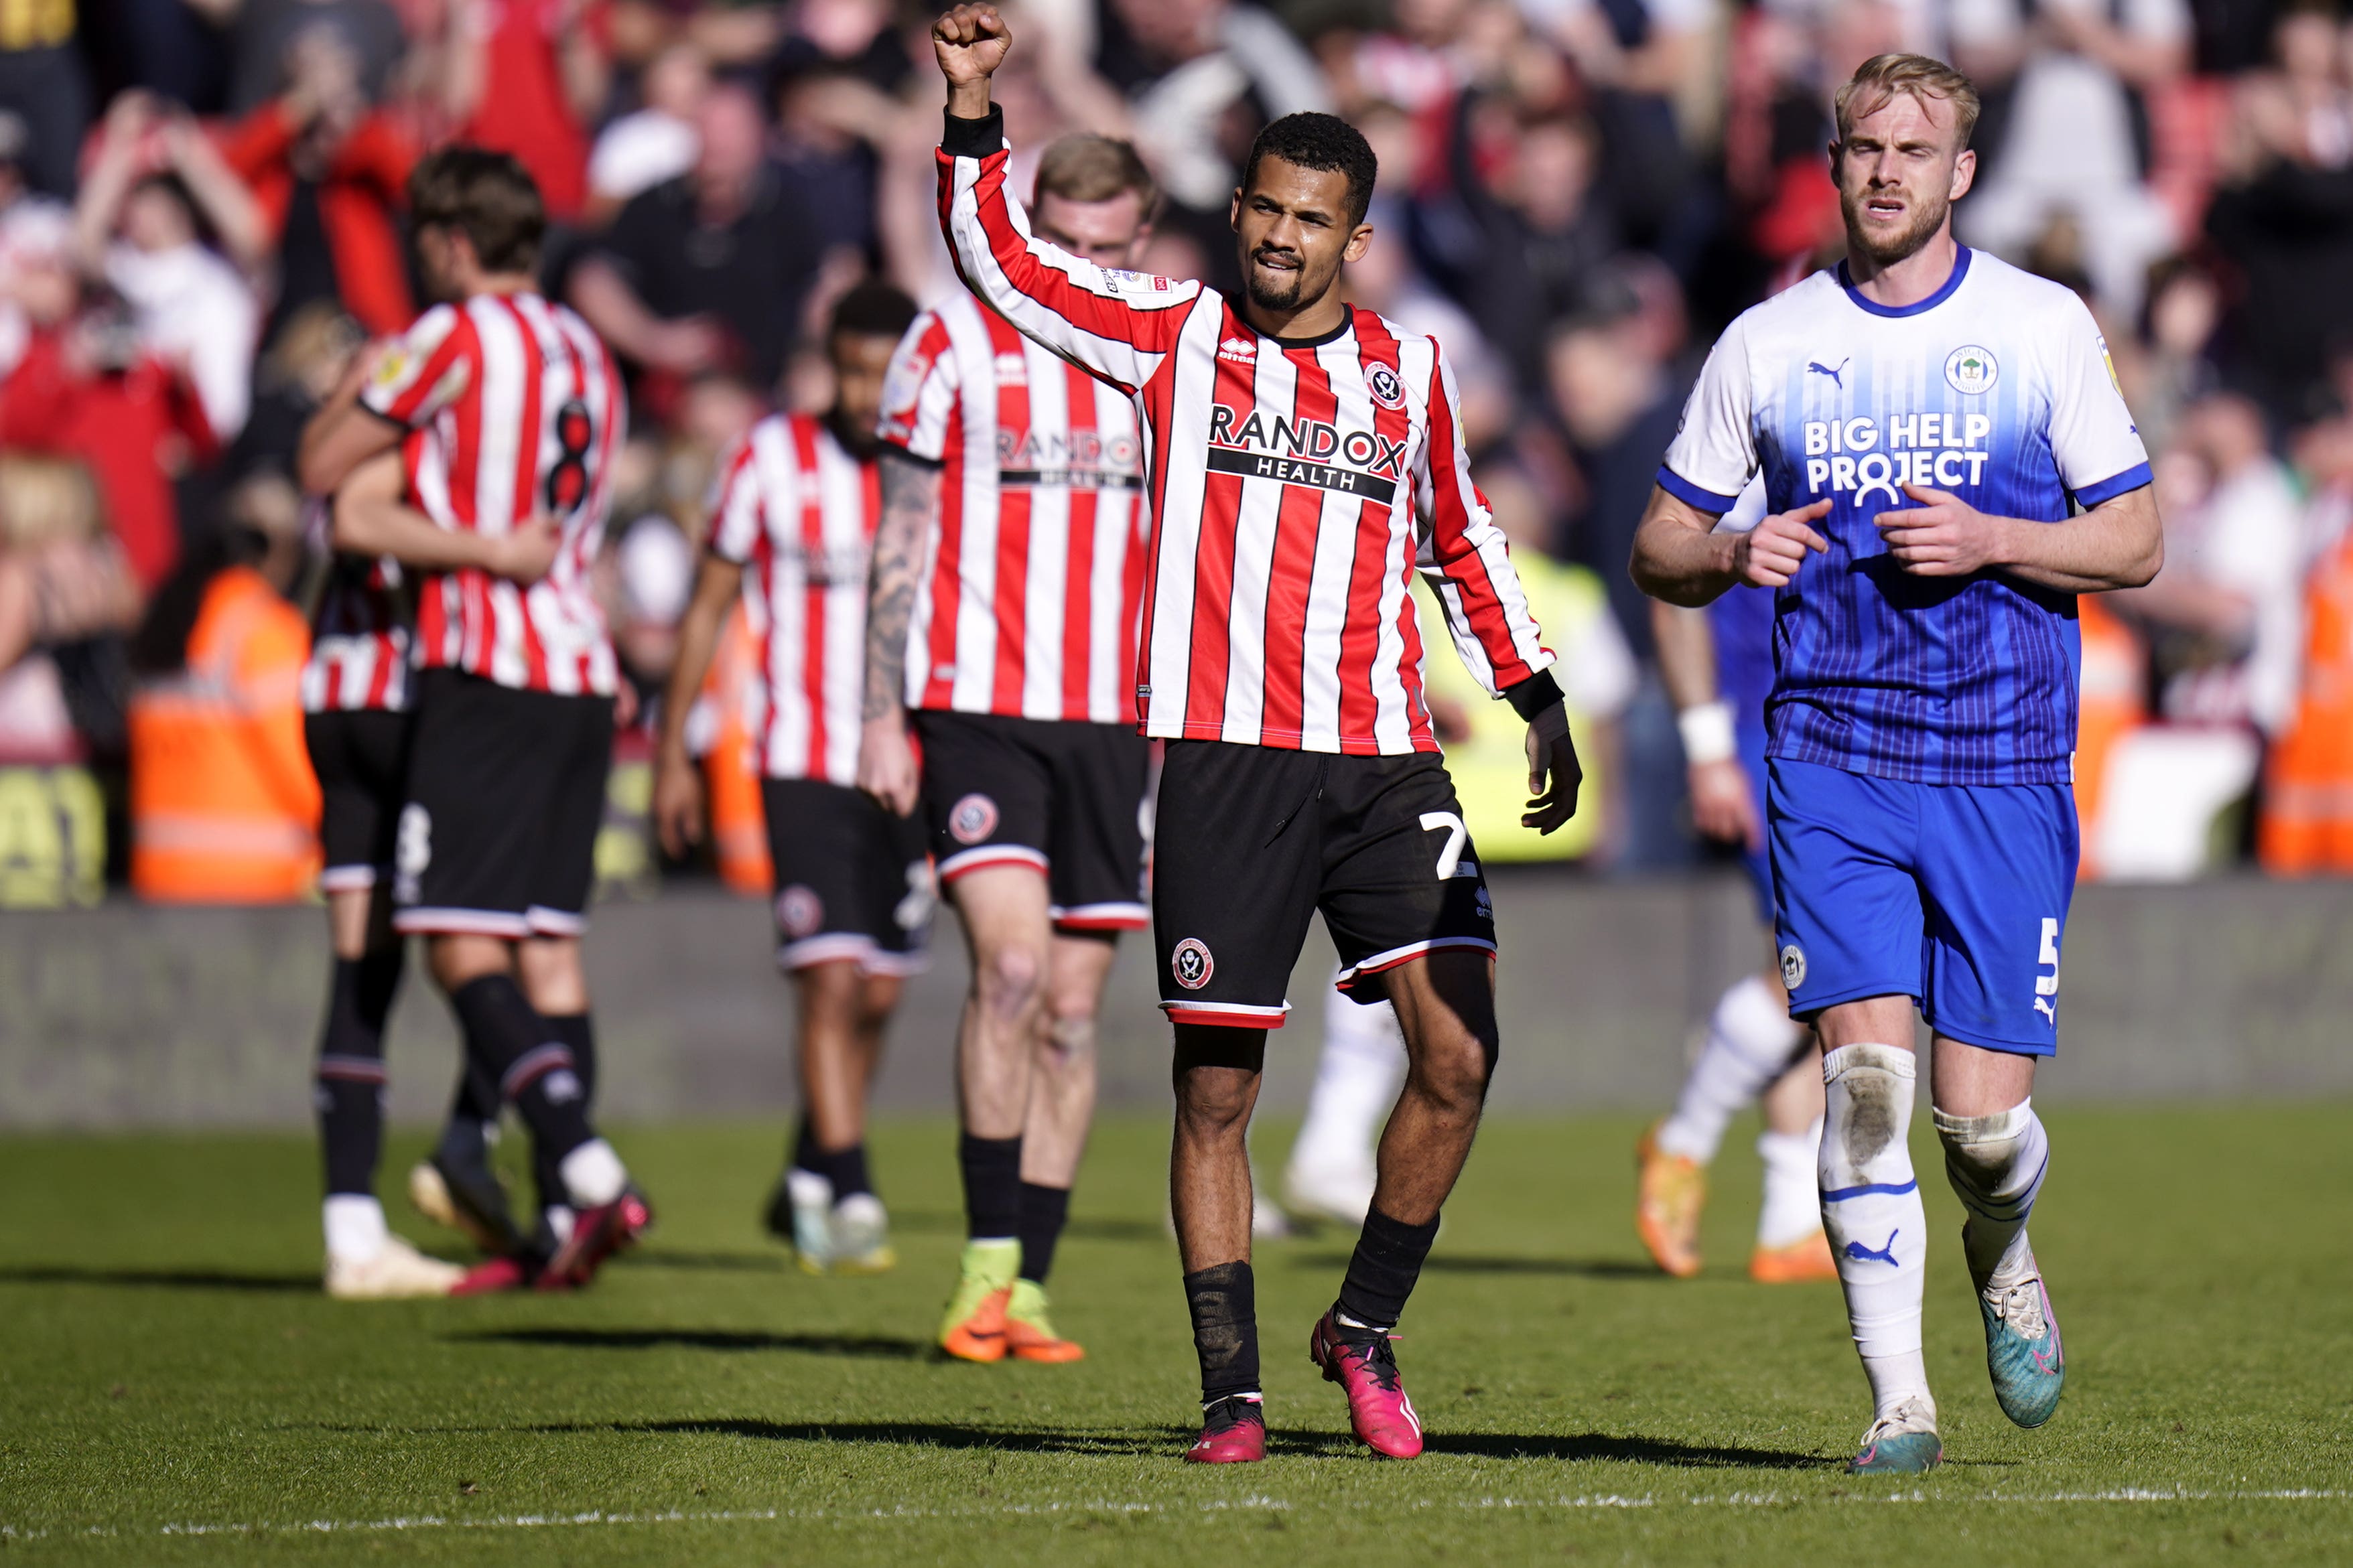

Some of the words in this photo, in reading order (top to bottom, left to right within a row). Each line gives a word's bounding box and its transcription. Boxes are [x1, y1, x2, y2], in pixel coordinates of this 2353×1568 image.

[1156, 277, 1166, 290] bet
[547, 398, 591, 519] 8
[996, 427, 1138, 468] RANDO
[1209, 404, 1408, 478] RANDOX
[1804, 416, 1879, 456] BIG
[1889, 412, 1992, 449] HELP
[1256, 457, 1356, 491] HEALTH
[1806, 451, 1989, 507] PROJECT
[2035, 917, 2059, 996] 5
